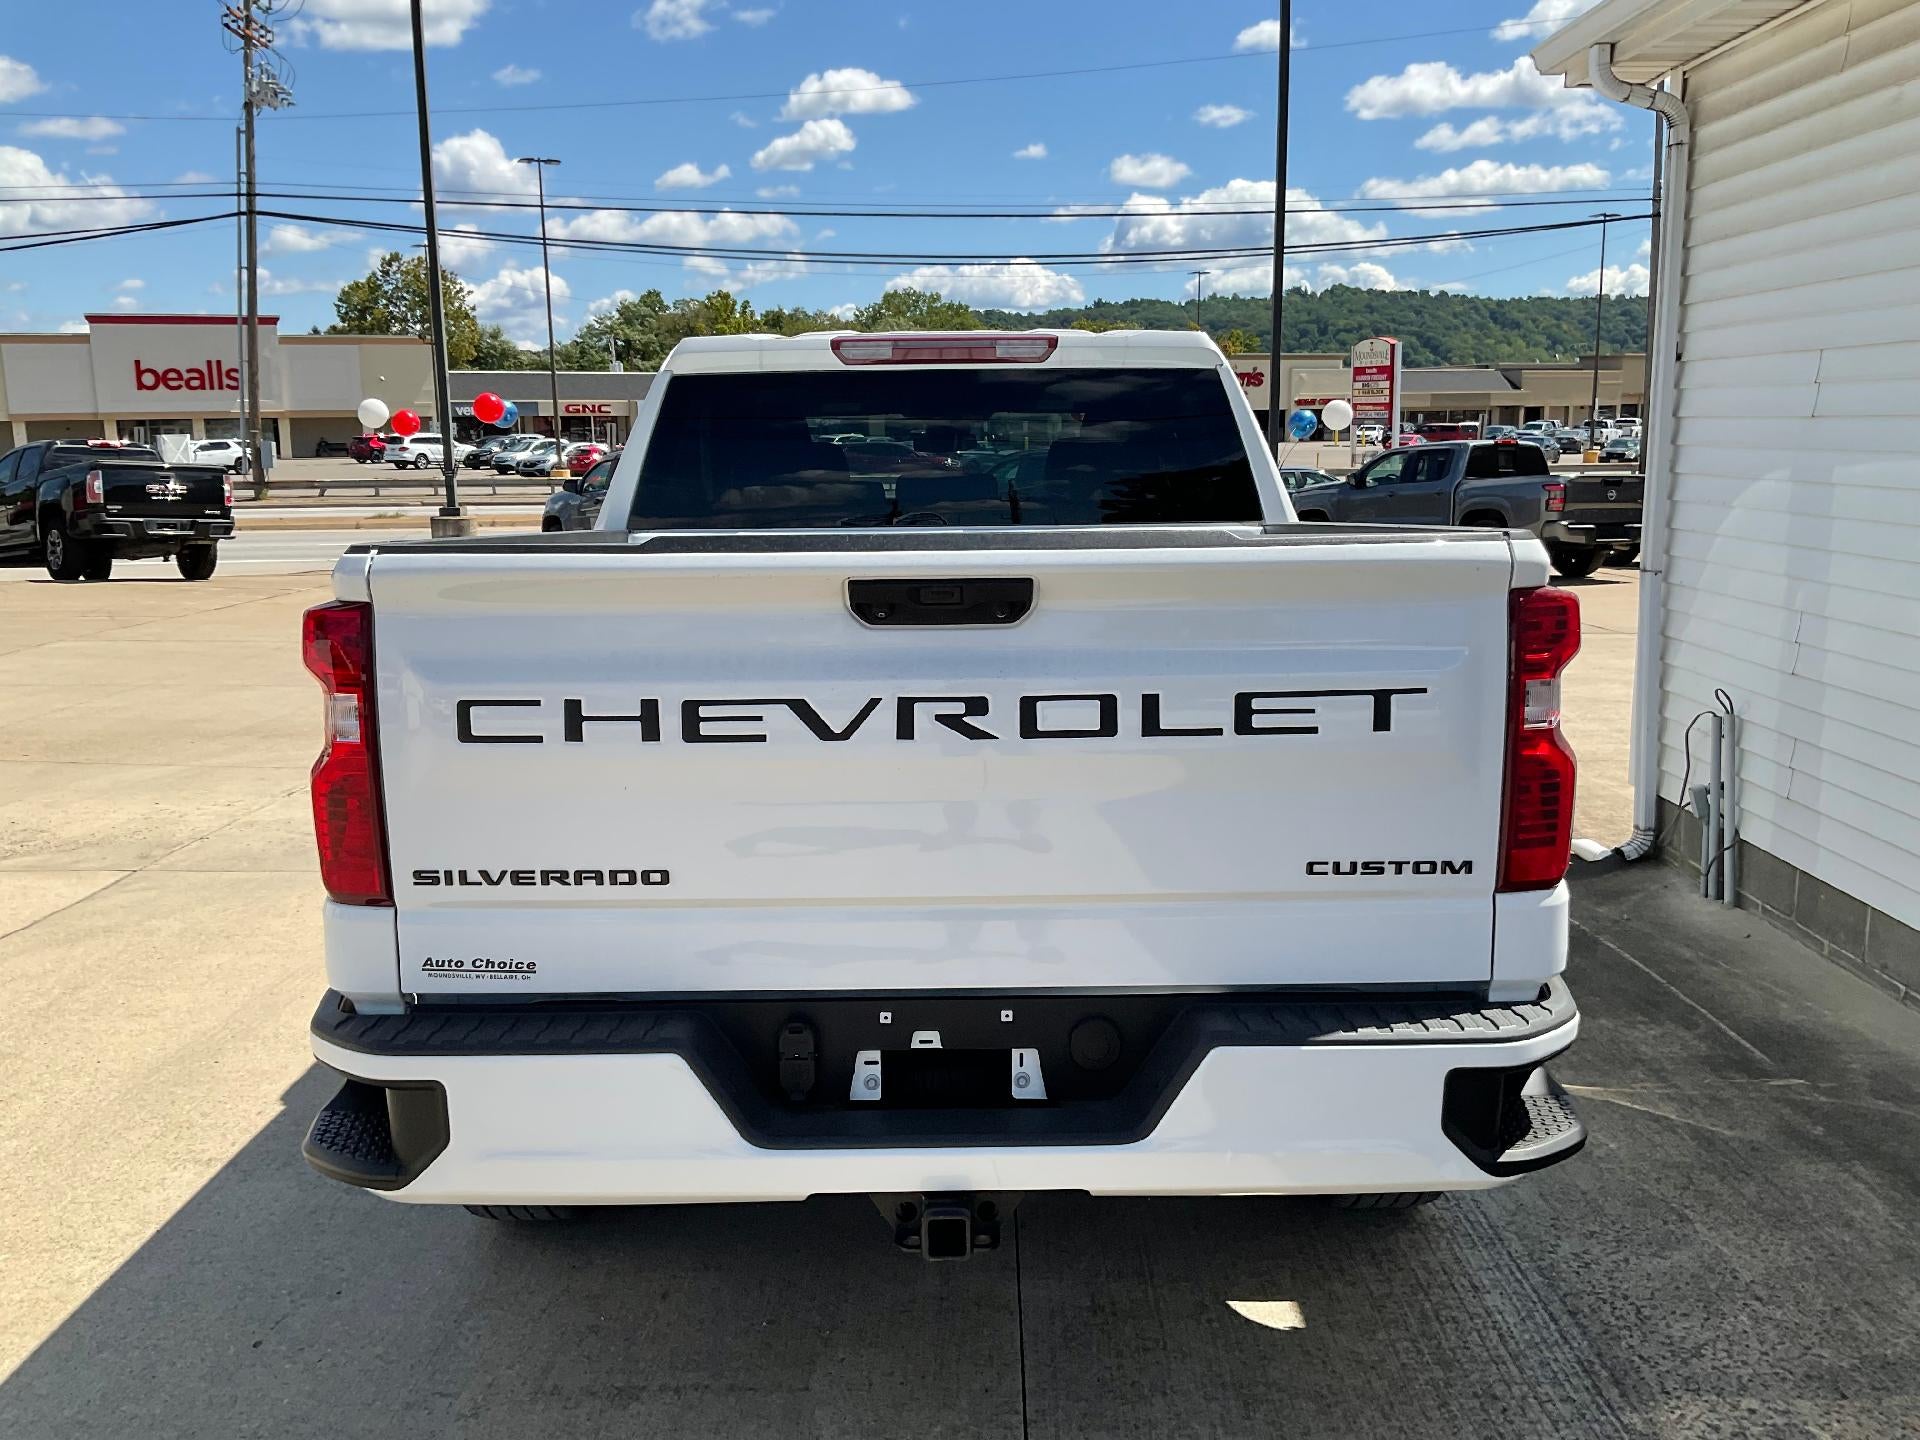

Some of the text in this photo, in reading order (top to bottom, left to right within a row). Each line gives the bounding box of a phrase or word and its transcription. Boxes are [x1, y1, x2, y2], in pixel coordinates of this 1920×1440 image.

[133, 359, 240, 391] bealls
[564, 403, 612, 414] GNC
[456, 687, 1428, 744] CHEVROLET
[1305, 860, 1473, 876] CUSTOM
[412, 869, 671, 887] SILVERADO
[421, 956, 537, 970] Auto Choice
